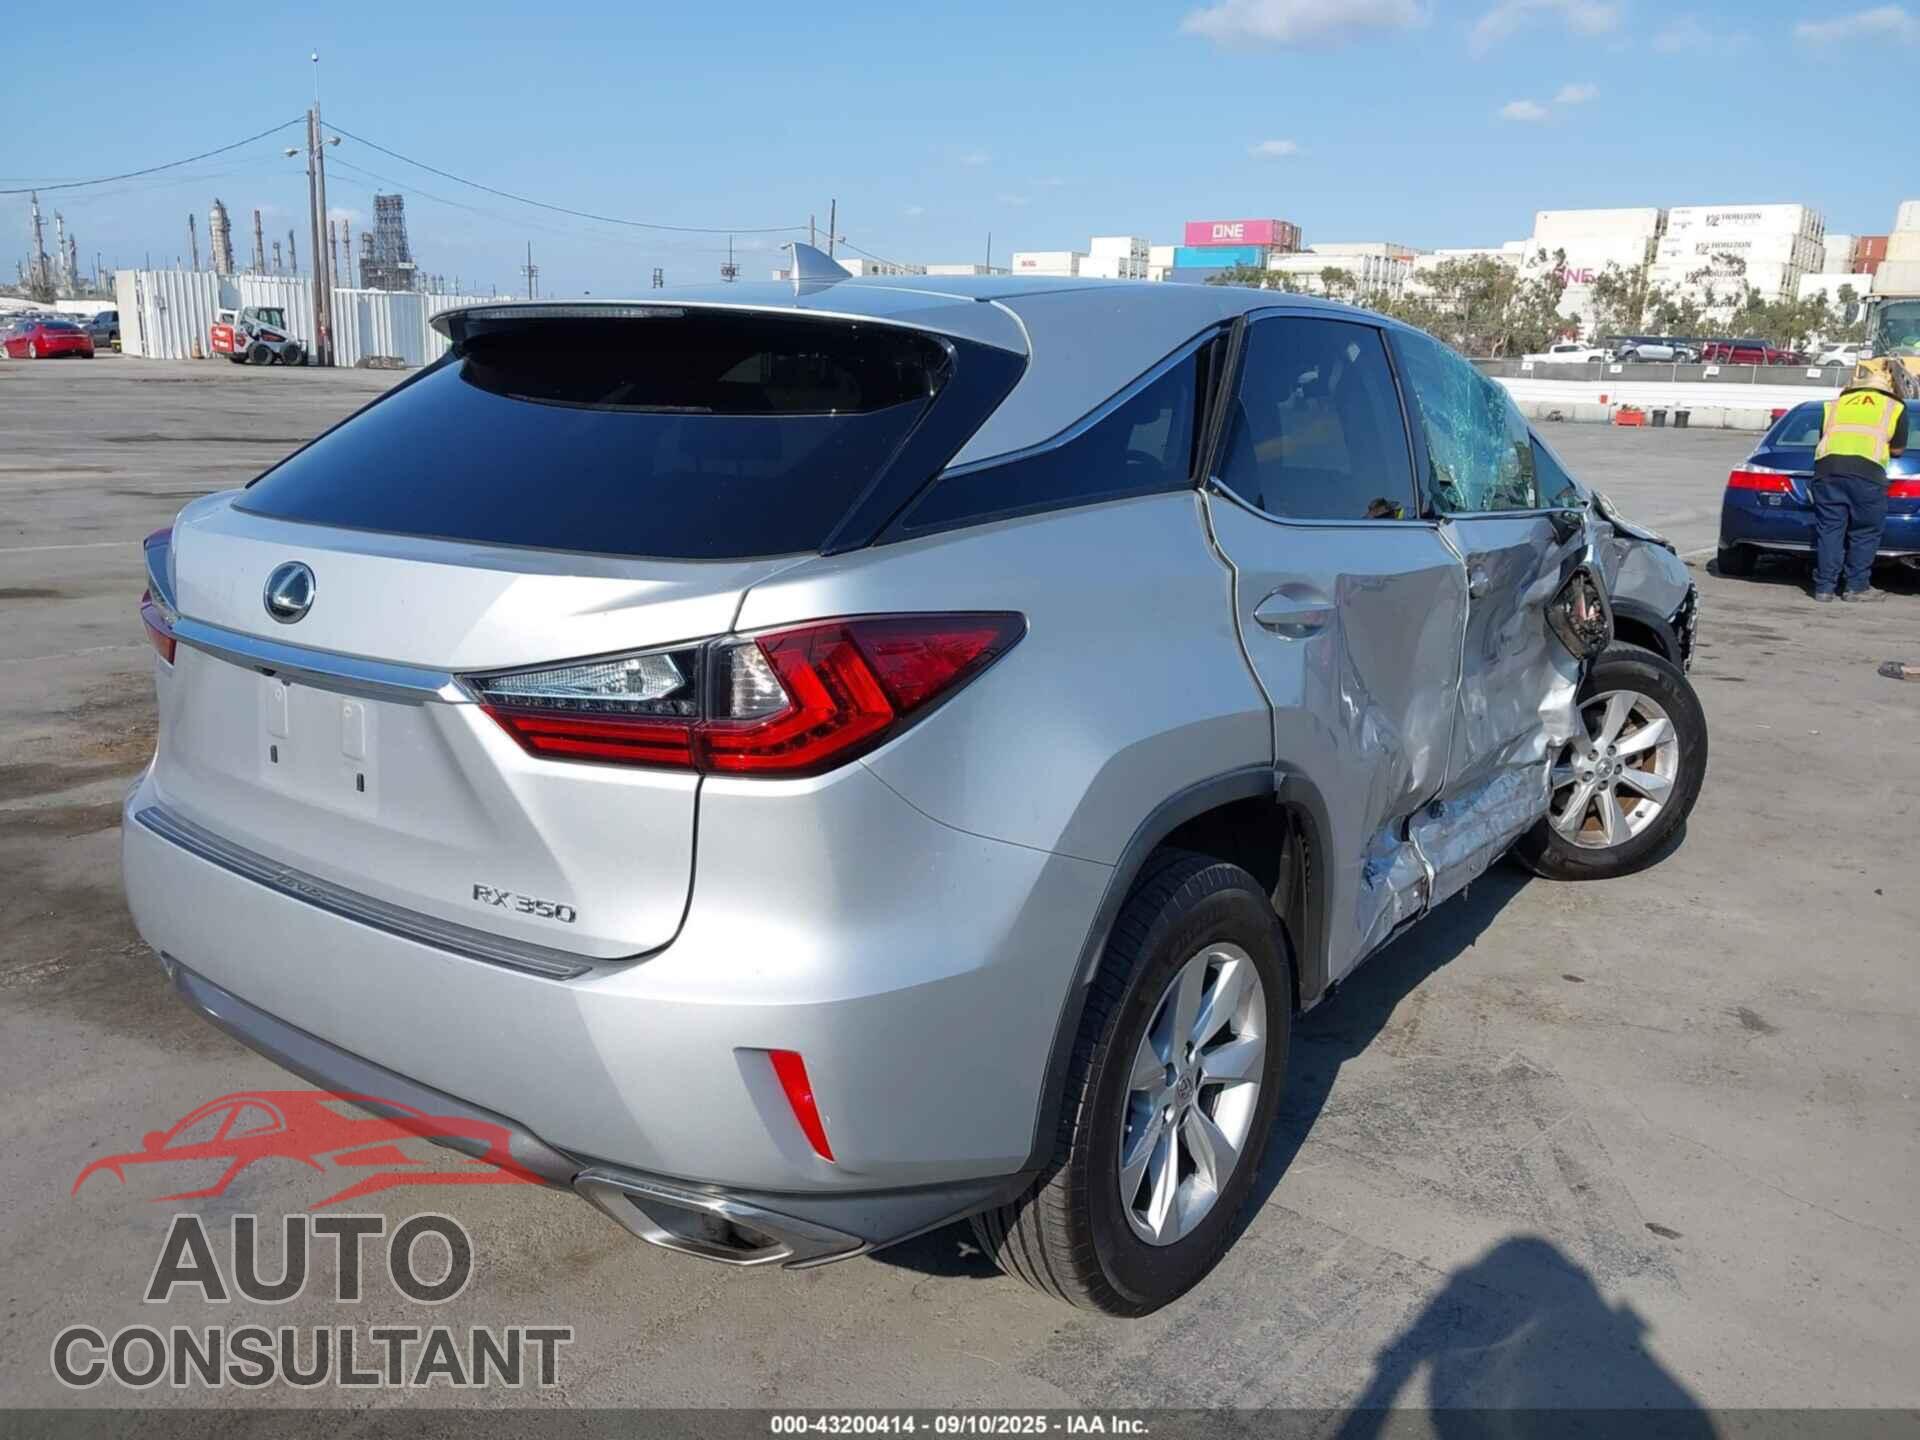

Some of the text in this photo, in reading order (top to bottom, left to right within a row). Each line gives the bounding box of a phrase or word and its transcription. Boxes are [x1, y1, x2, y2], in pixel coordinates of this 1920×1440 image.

[1212, 223, 1244, 238] ONE
[472, 883, 577, 924] RX 350
